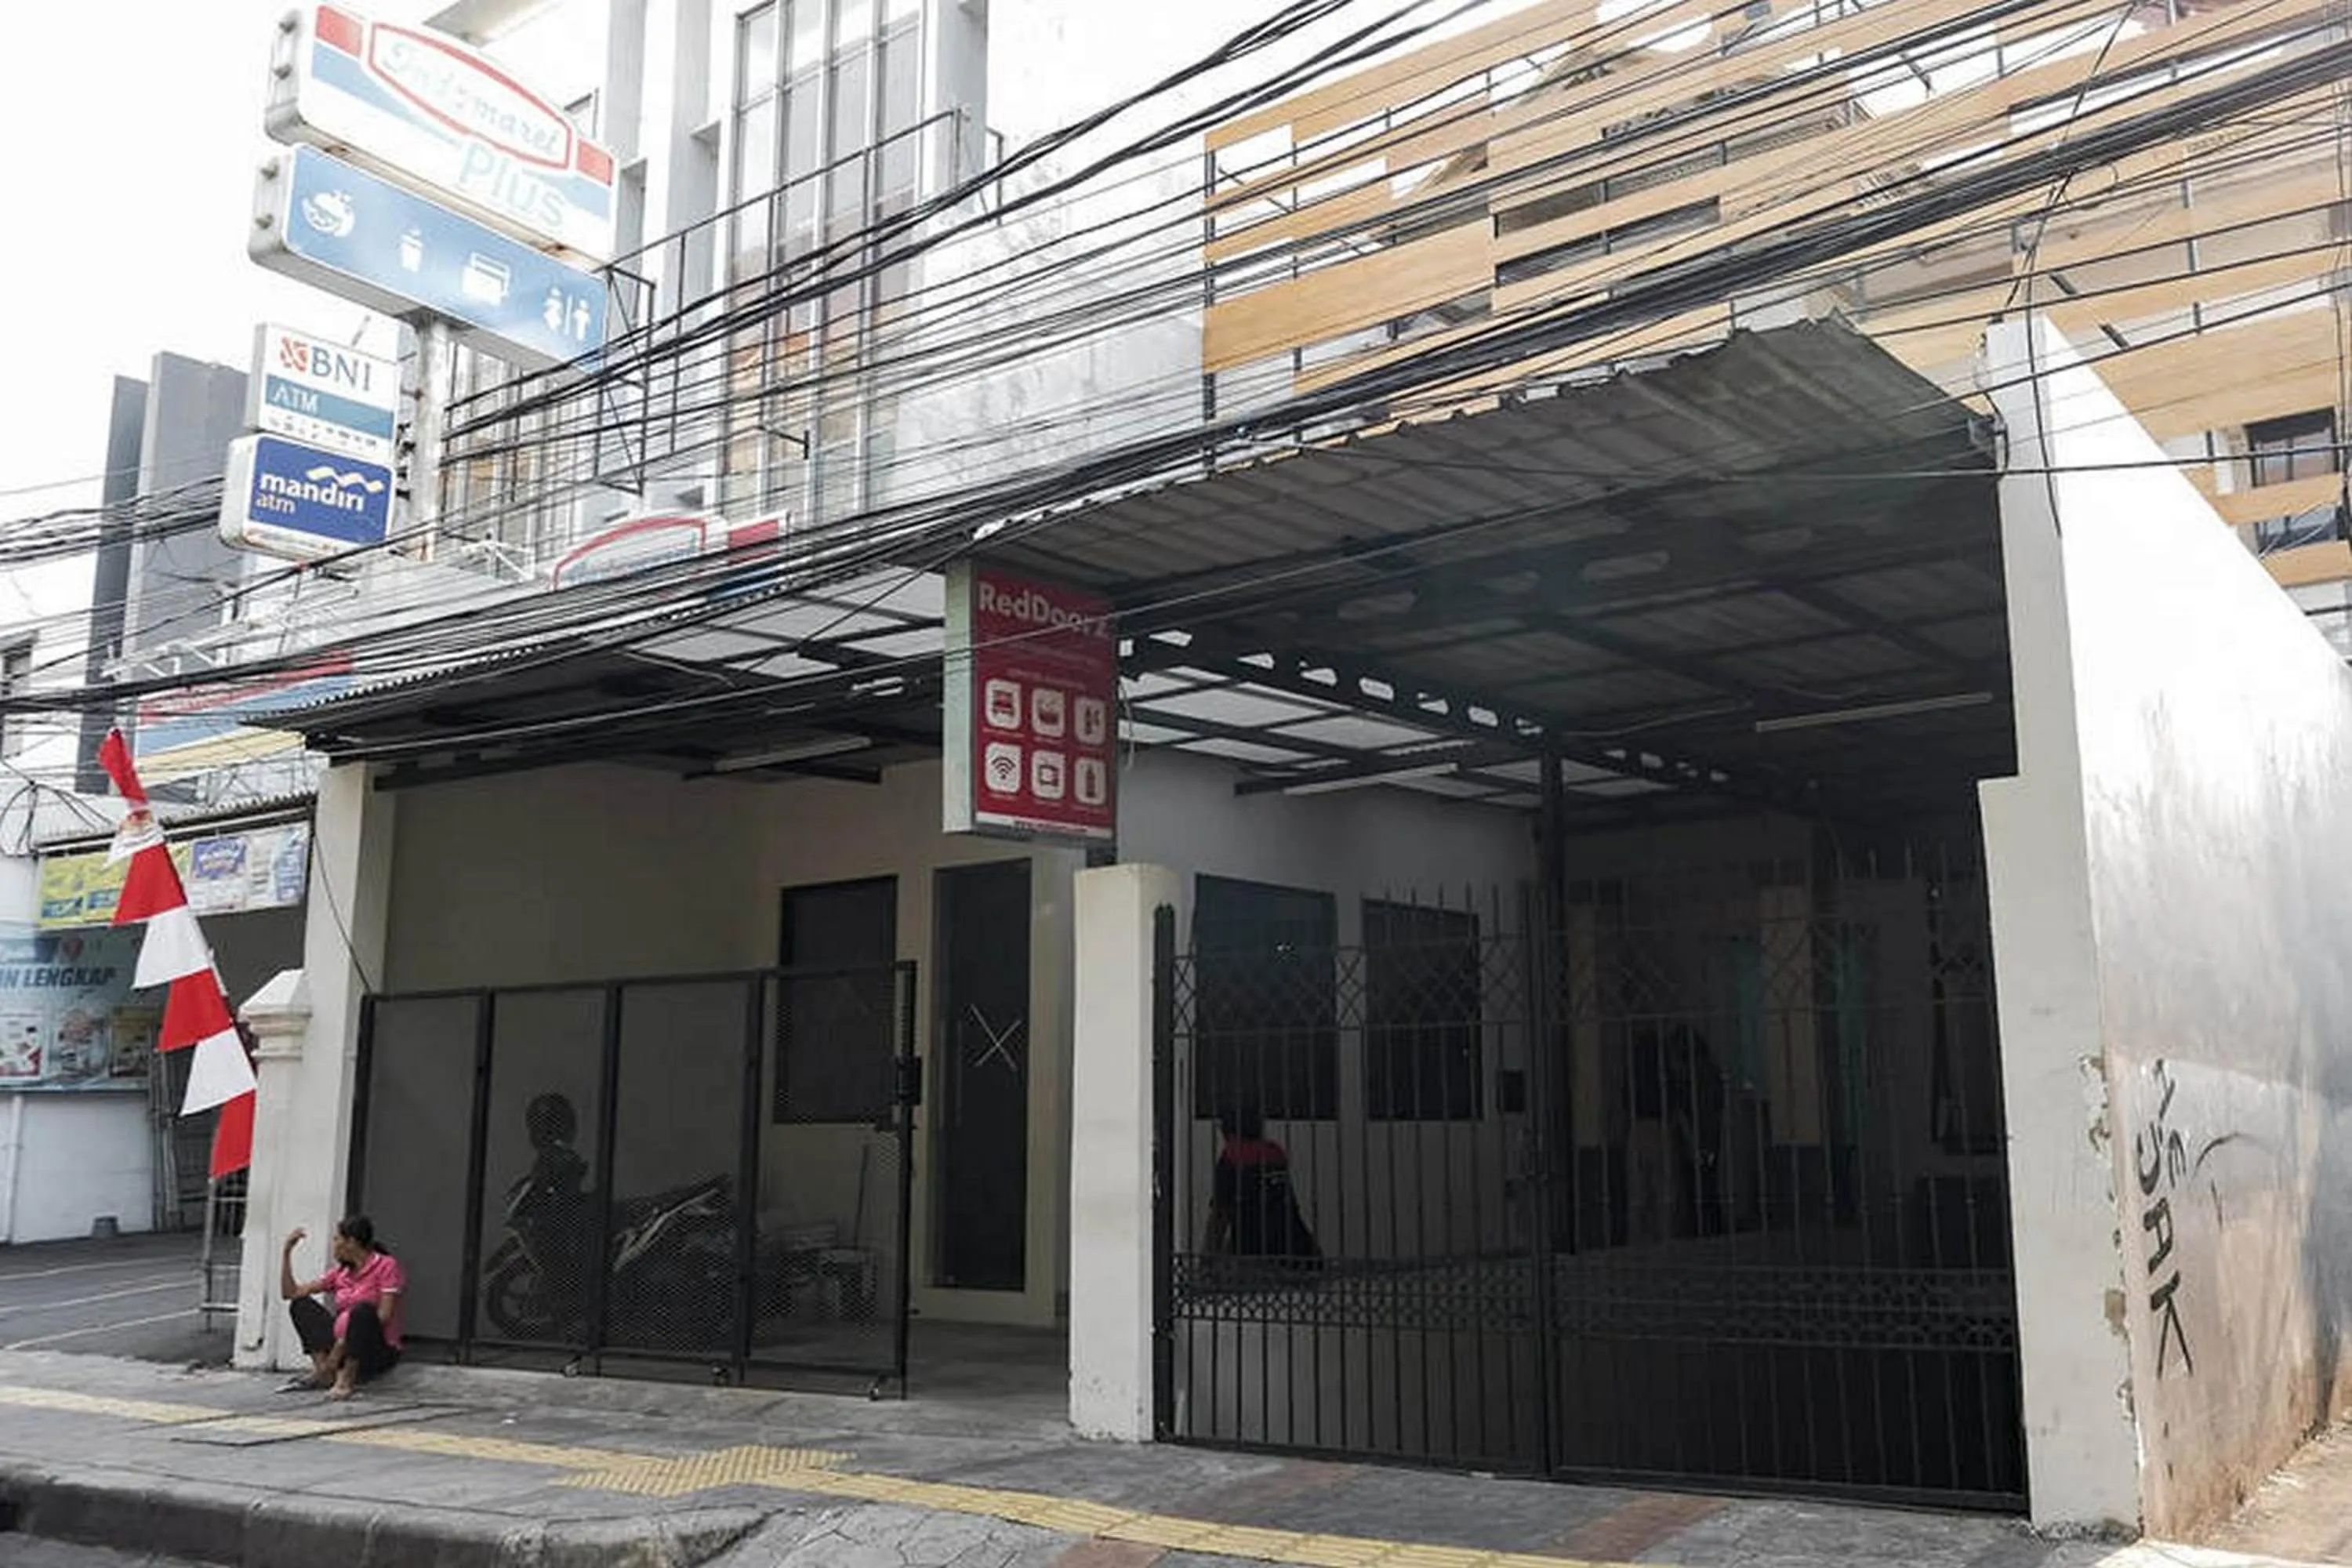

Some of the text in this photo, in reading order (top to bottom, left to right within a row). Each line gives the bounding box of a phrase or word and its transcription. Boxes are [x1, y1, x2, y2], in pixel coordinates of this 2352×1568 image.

[311, 345, 371, 391] BNI
[273, 383, 318, 414] ATM
[256, 492, 296, 514] atm
[260, 473, 365, 512] mandiri
[23, 966, 116, 987] LENGKAP
